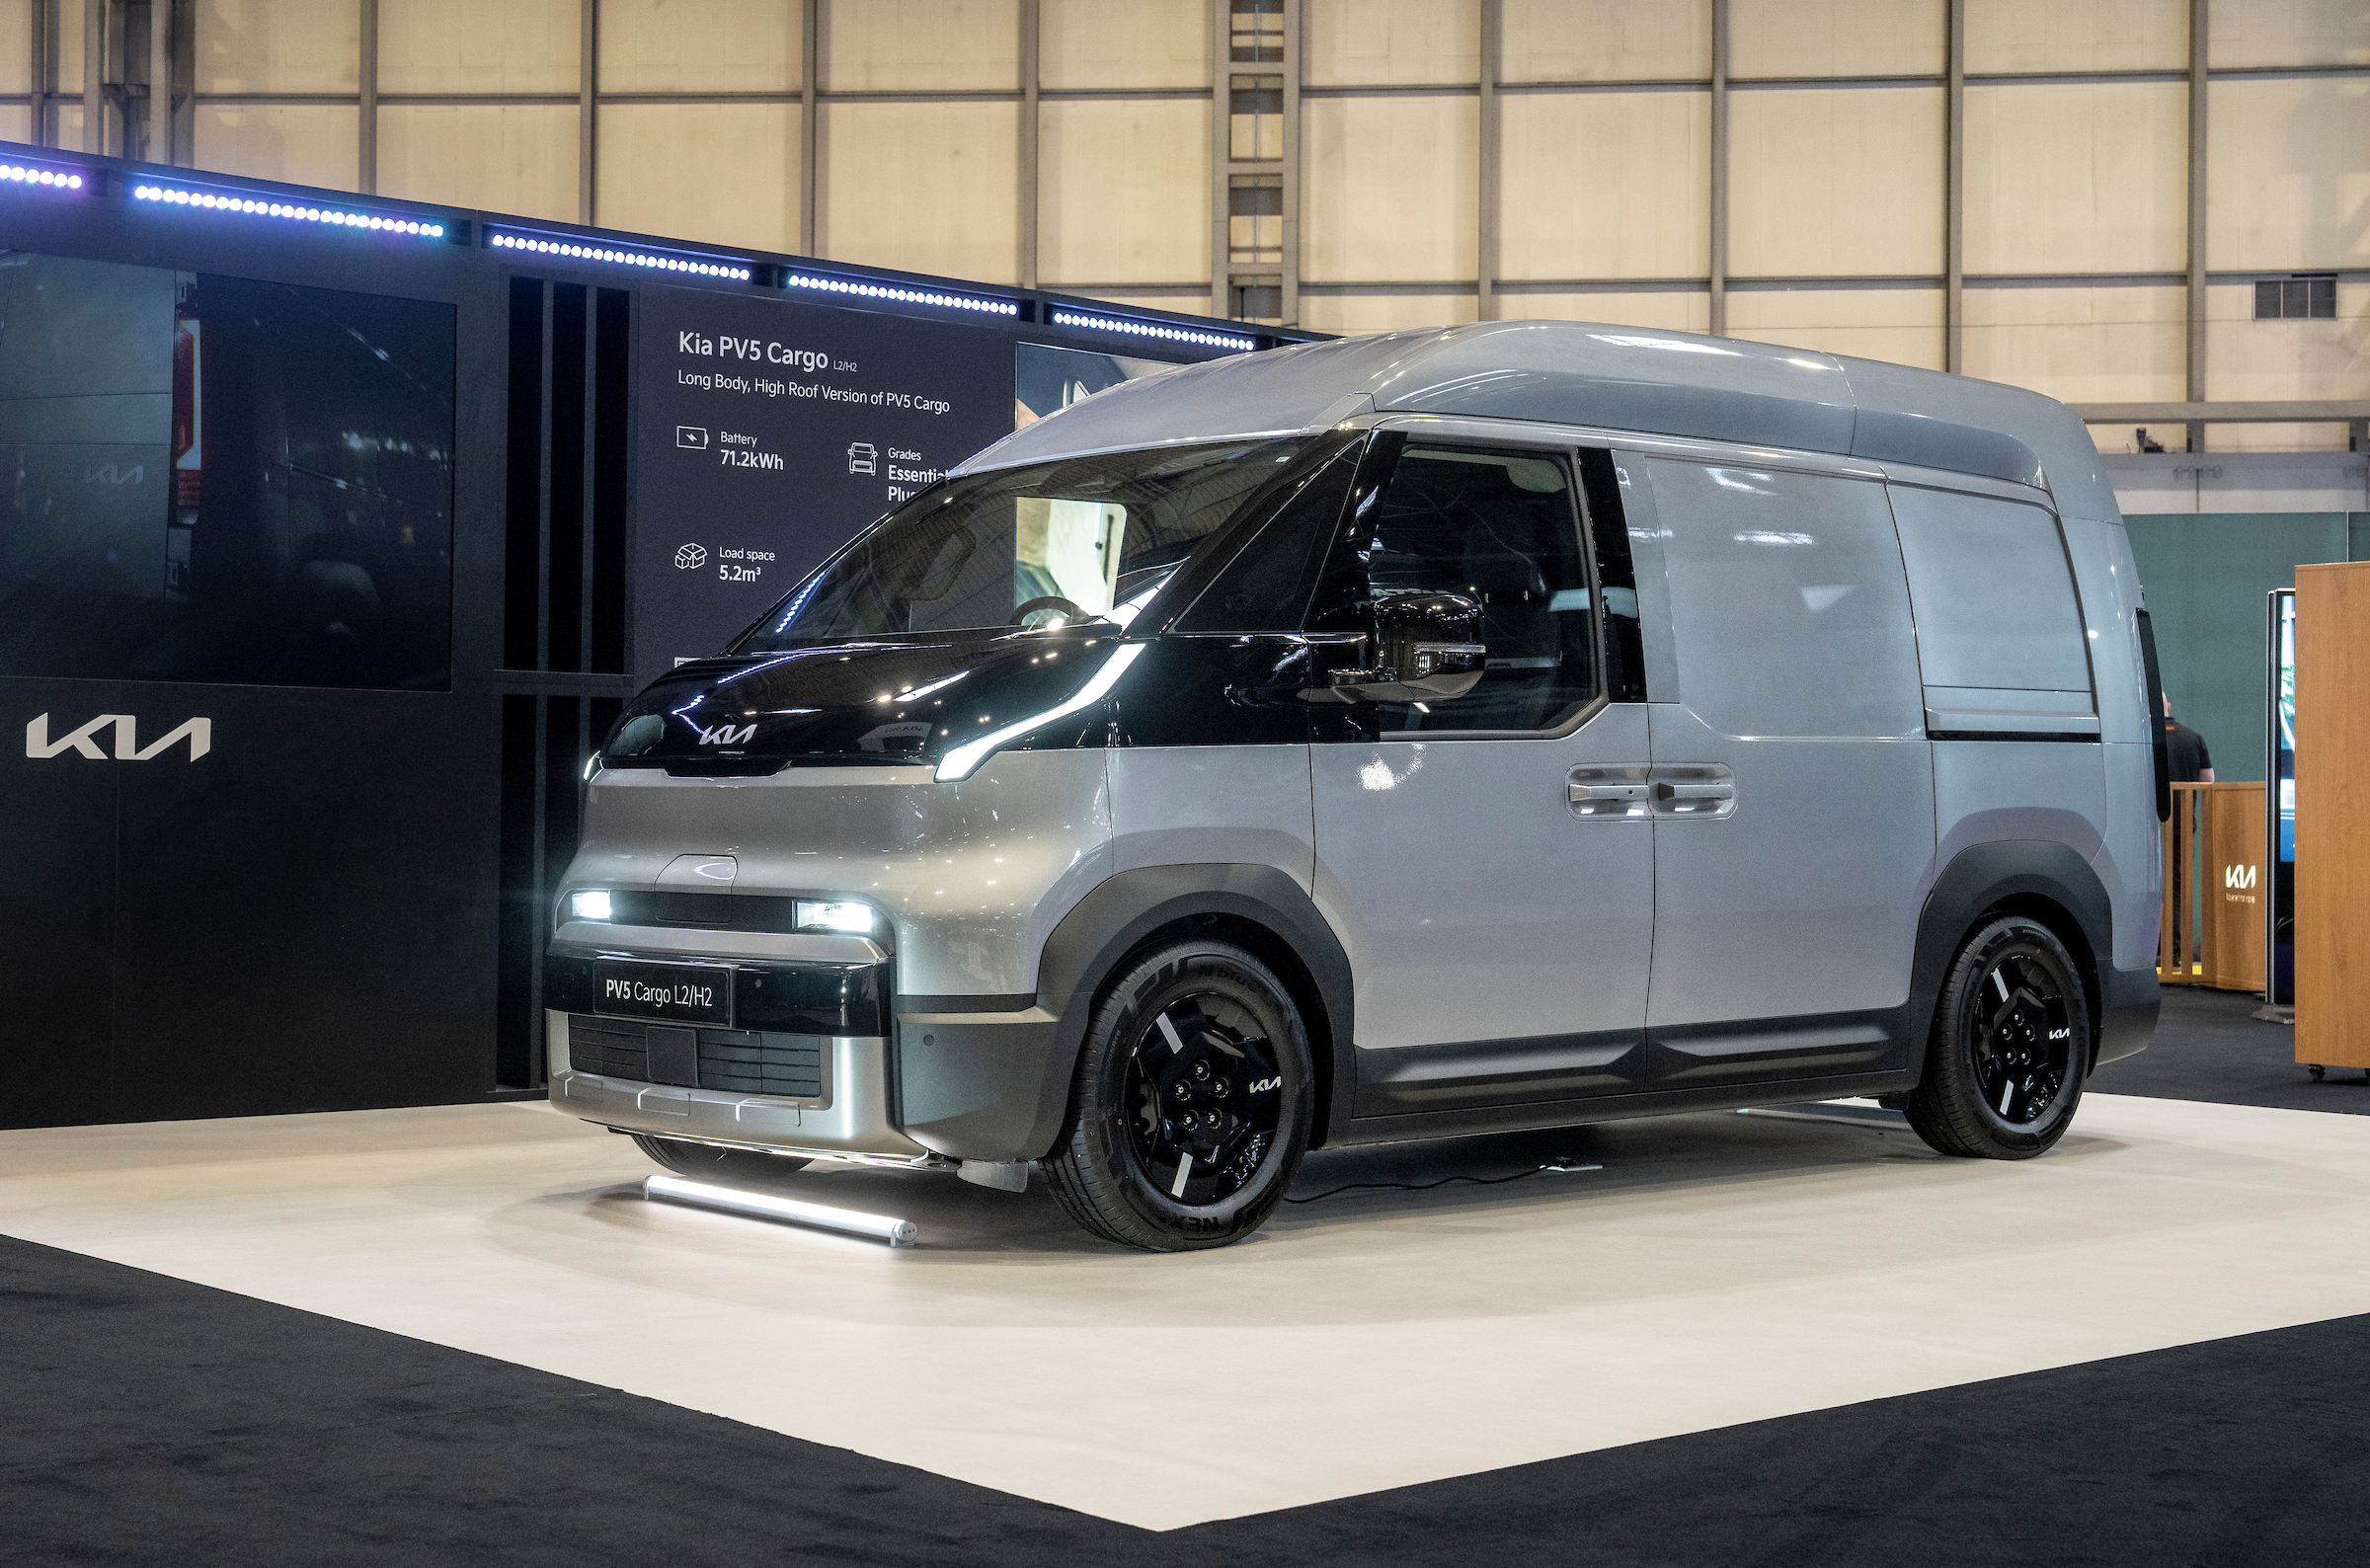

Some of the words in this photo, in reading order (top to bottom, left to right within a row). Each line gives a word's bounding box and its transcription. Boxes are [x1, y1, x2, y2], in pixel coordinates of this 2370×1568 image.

[678, 331, 713, 356] Kia
[719, 335, 761, 361] PV5
[766, 342, 829, 373] Cargo
[832, 359, 858, 373] L2/H2
[677, 368, 711, 391] Long
[715, 373, 751, 395] Body,
[754, 377, 785, 398] High
[788, 381, 819, 399] Roof
[821, 384, 868, 404] Version
[870, 390, 884, 406] of
[886, 392, 911, 409] PV5
[913, 395, 950, 415] Cargo
[720, 431, 758, 448] Battery
[720, 448, 784, 471] 71.2kWh
[888, 446, 922, 461] Grades
[888, 486, 916, 503] Plu
[719, 546, 745, 560] Load
[746, 550, 776, 563] space
[25, 712, 212, 762] KIA
[699, 724, 758, 745] KIA
[2225, 864, 2256, 890] KIA
[605, 979, 632, 1000] PV5
[633, 980, 672, 1008] Cargo
[673, 984, 713, 1008] L2/H2
[2048, 1027, 2071, 1040] KIA
[1248, 1075, 1282, 1094] KIA
